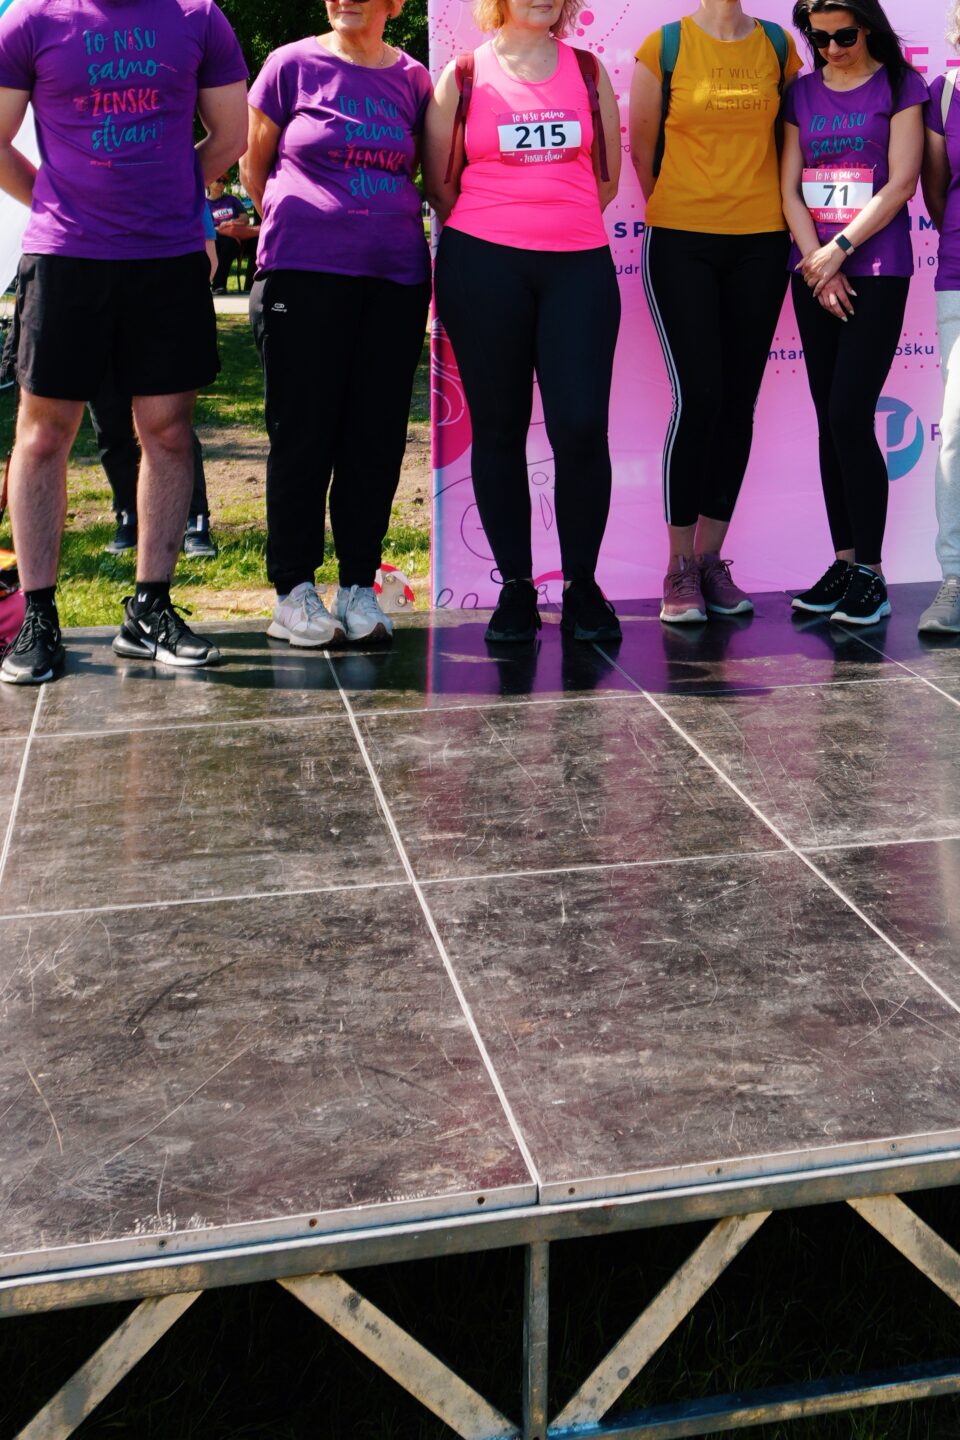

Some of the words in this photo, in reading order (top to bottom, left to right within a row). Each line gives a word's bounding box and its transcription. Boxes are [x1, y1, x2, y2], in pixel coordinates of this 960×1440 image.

[88, 58, 158, 86] samo
[711, 68, 724, 79] IT
[729, 68, 763, 79] WILL
[90, 88, 160, 117] ŽENSKE
[705, 98, 771, 112] ALRIGHT
[515, 124, 567, 149] 215
[823, 184, 849, 206] 71
